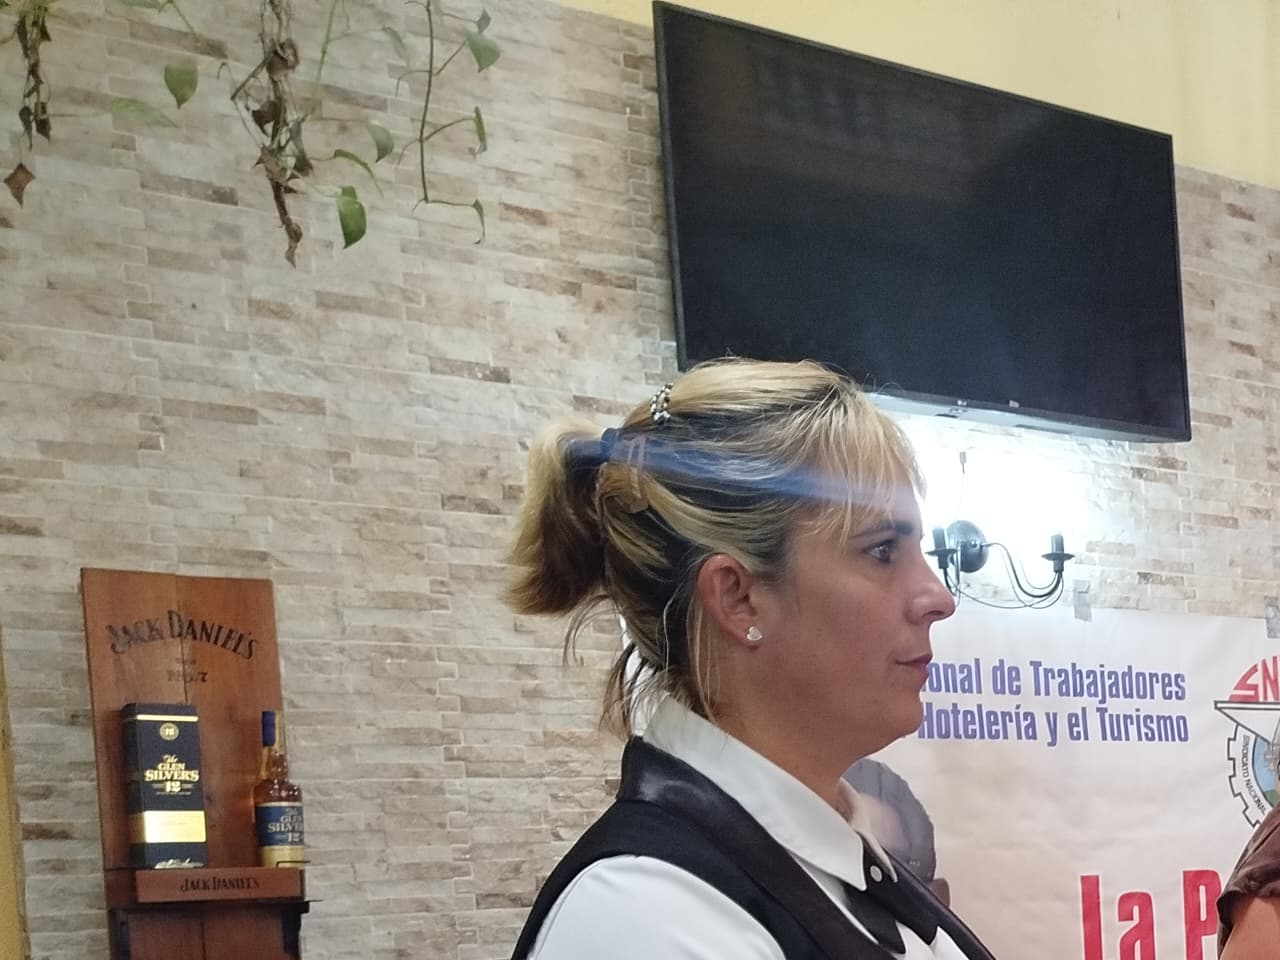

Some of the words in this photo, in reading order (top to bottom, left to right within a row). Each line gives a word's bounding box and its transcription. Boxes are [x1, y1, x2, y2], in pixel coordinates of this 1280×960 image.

[106, 618, 164, 655] JACK
[167, 610, 258, 660] DANIEL'S
[991, 658, 1021, 696] de
[1029, 660, 1186, 705] Trabajadores
[918, 702, 1038, 741] Hotelería
[1045, 711, 1058, 747] y
[1067, 706, 1089, 741] el
[1096, 706, 1189, 742] Turismo
